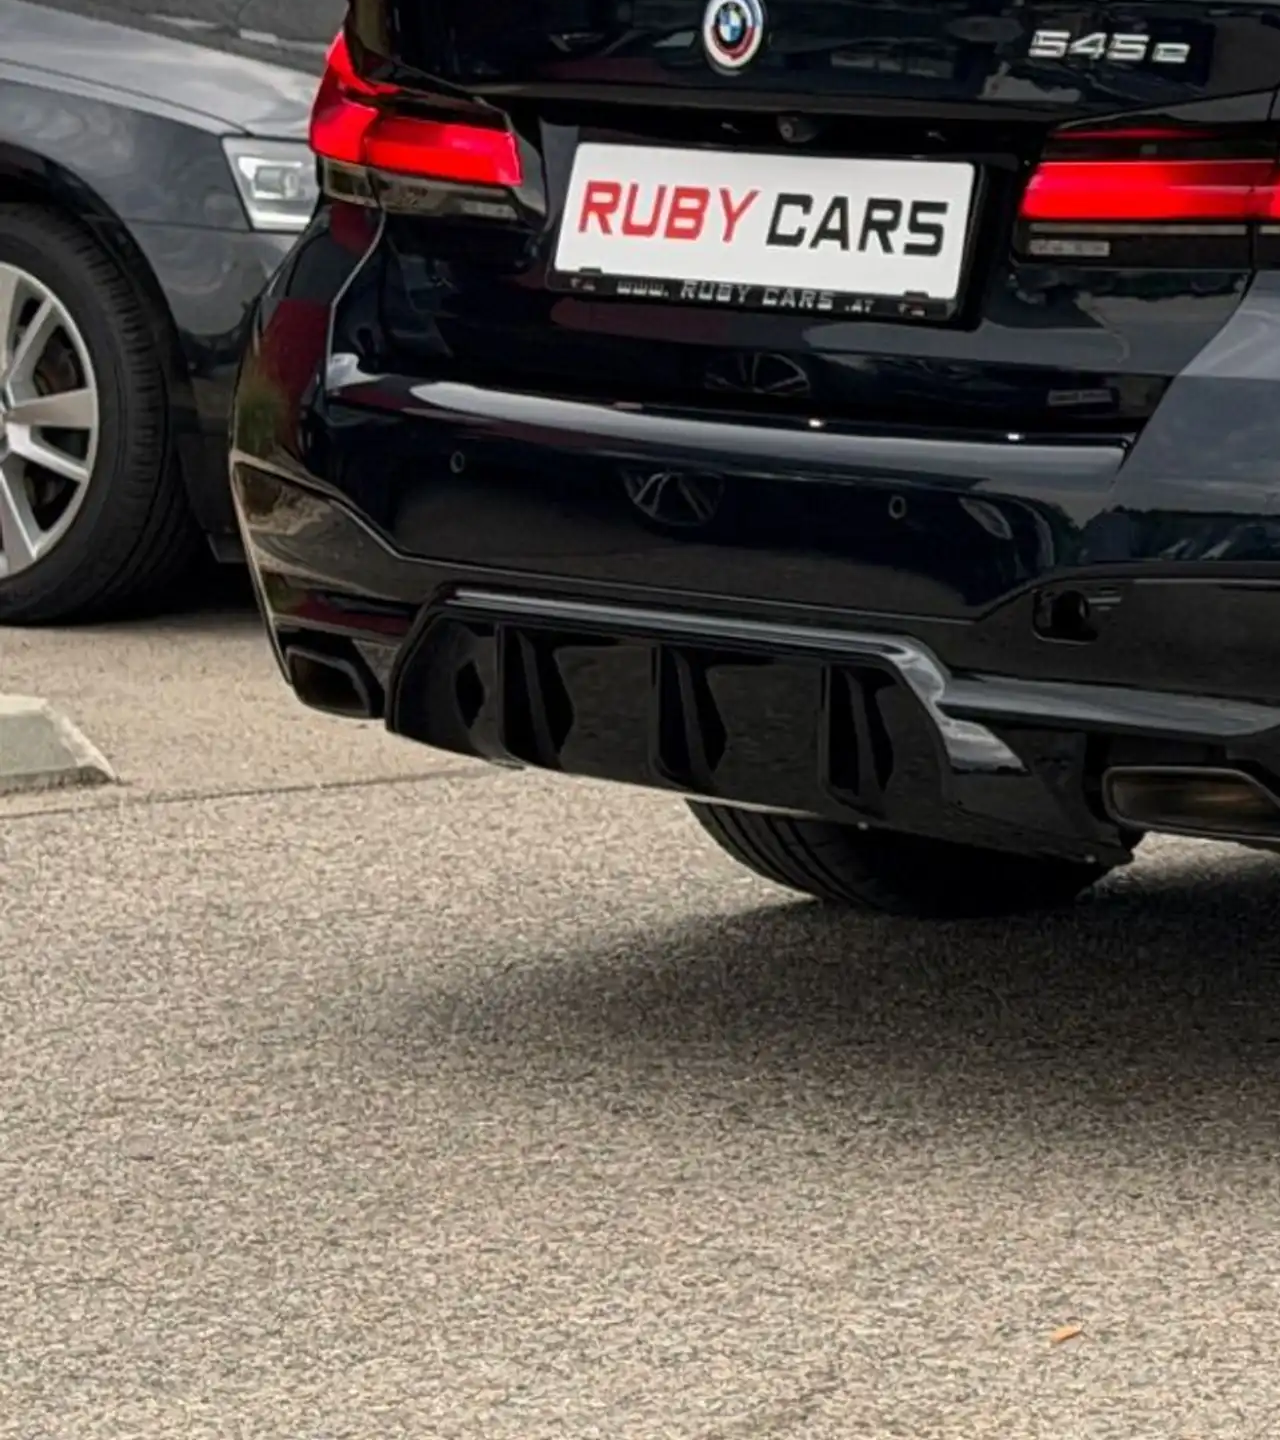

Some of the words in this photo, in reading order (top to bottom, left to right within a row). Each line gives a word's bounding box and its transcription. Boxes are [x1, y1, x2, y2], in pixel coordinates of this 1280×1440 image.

[578, 180, 760, 242] RUBY
[766, 193, 949, 257] CARS
[680, 279, 750, 303] RUBY
[762, 286, 835, 310] CARS
